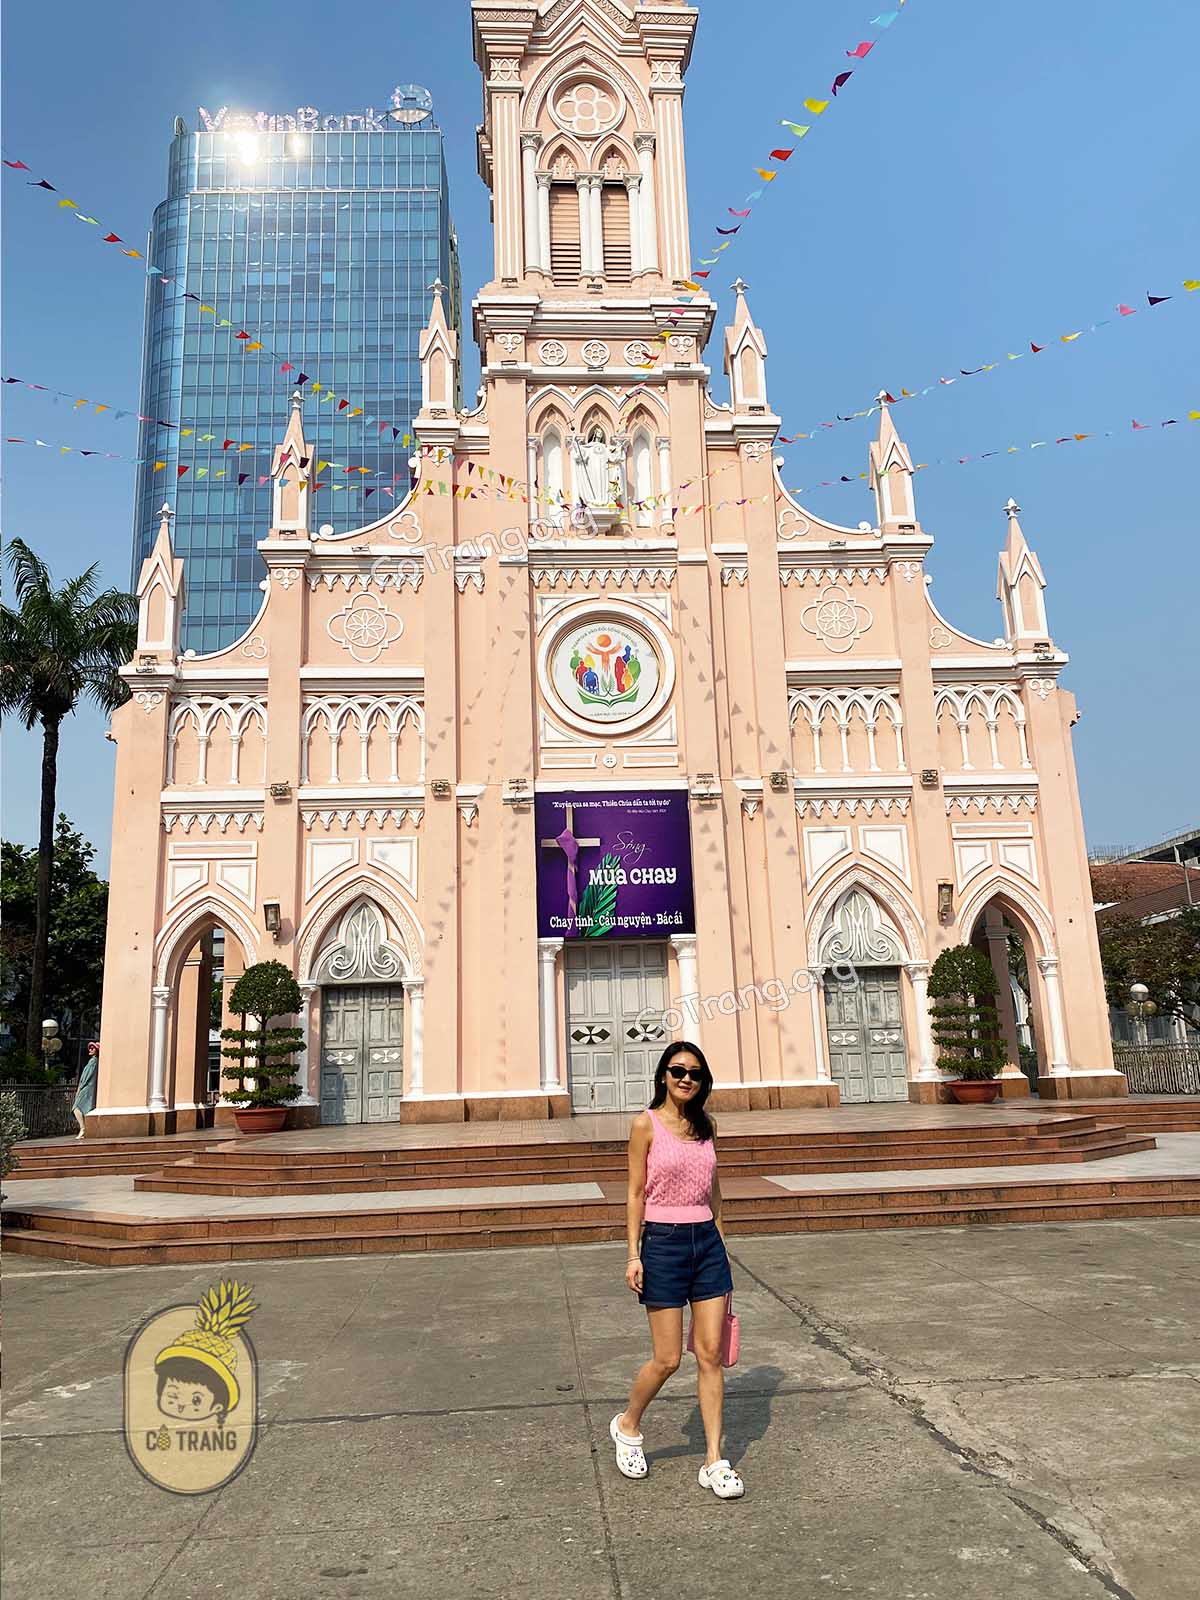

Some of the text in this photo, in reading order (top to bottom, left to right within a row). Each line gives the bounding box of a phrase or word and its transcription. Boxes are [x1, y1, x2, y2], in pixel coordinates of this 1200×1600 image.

[198, 105, 386, 132] VtinBank
[549, 916, 573, 930] Chay
[574, 915, 594, 930] tịnh
[599, 911, 616, 926] Cầu
[617, 912, 652, 928] nguyện
[656, 910, 673, 925] Bác
[674, 910, 683, 924] ái
